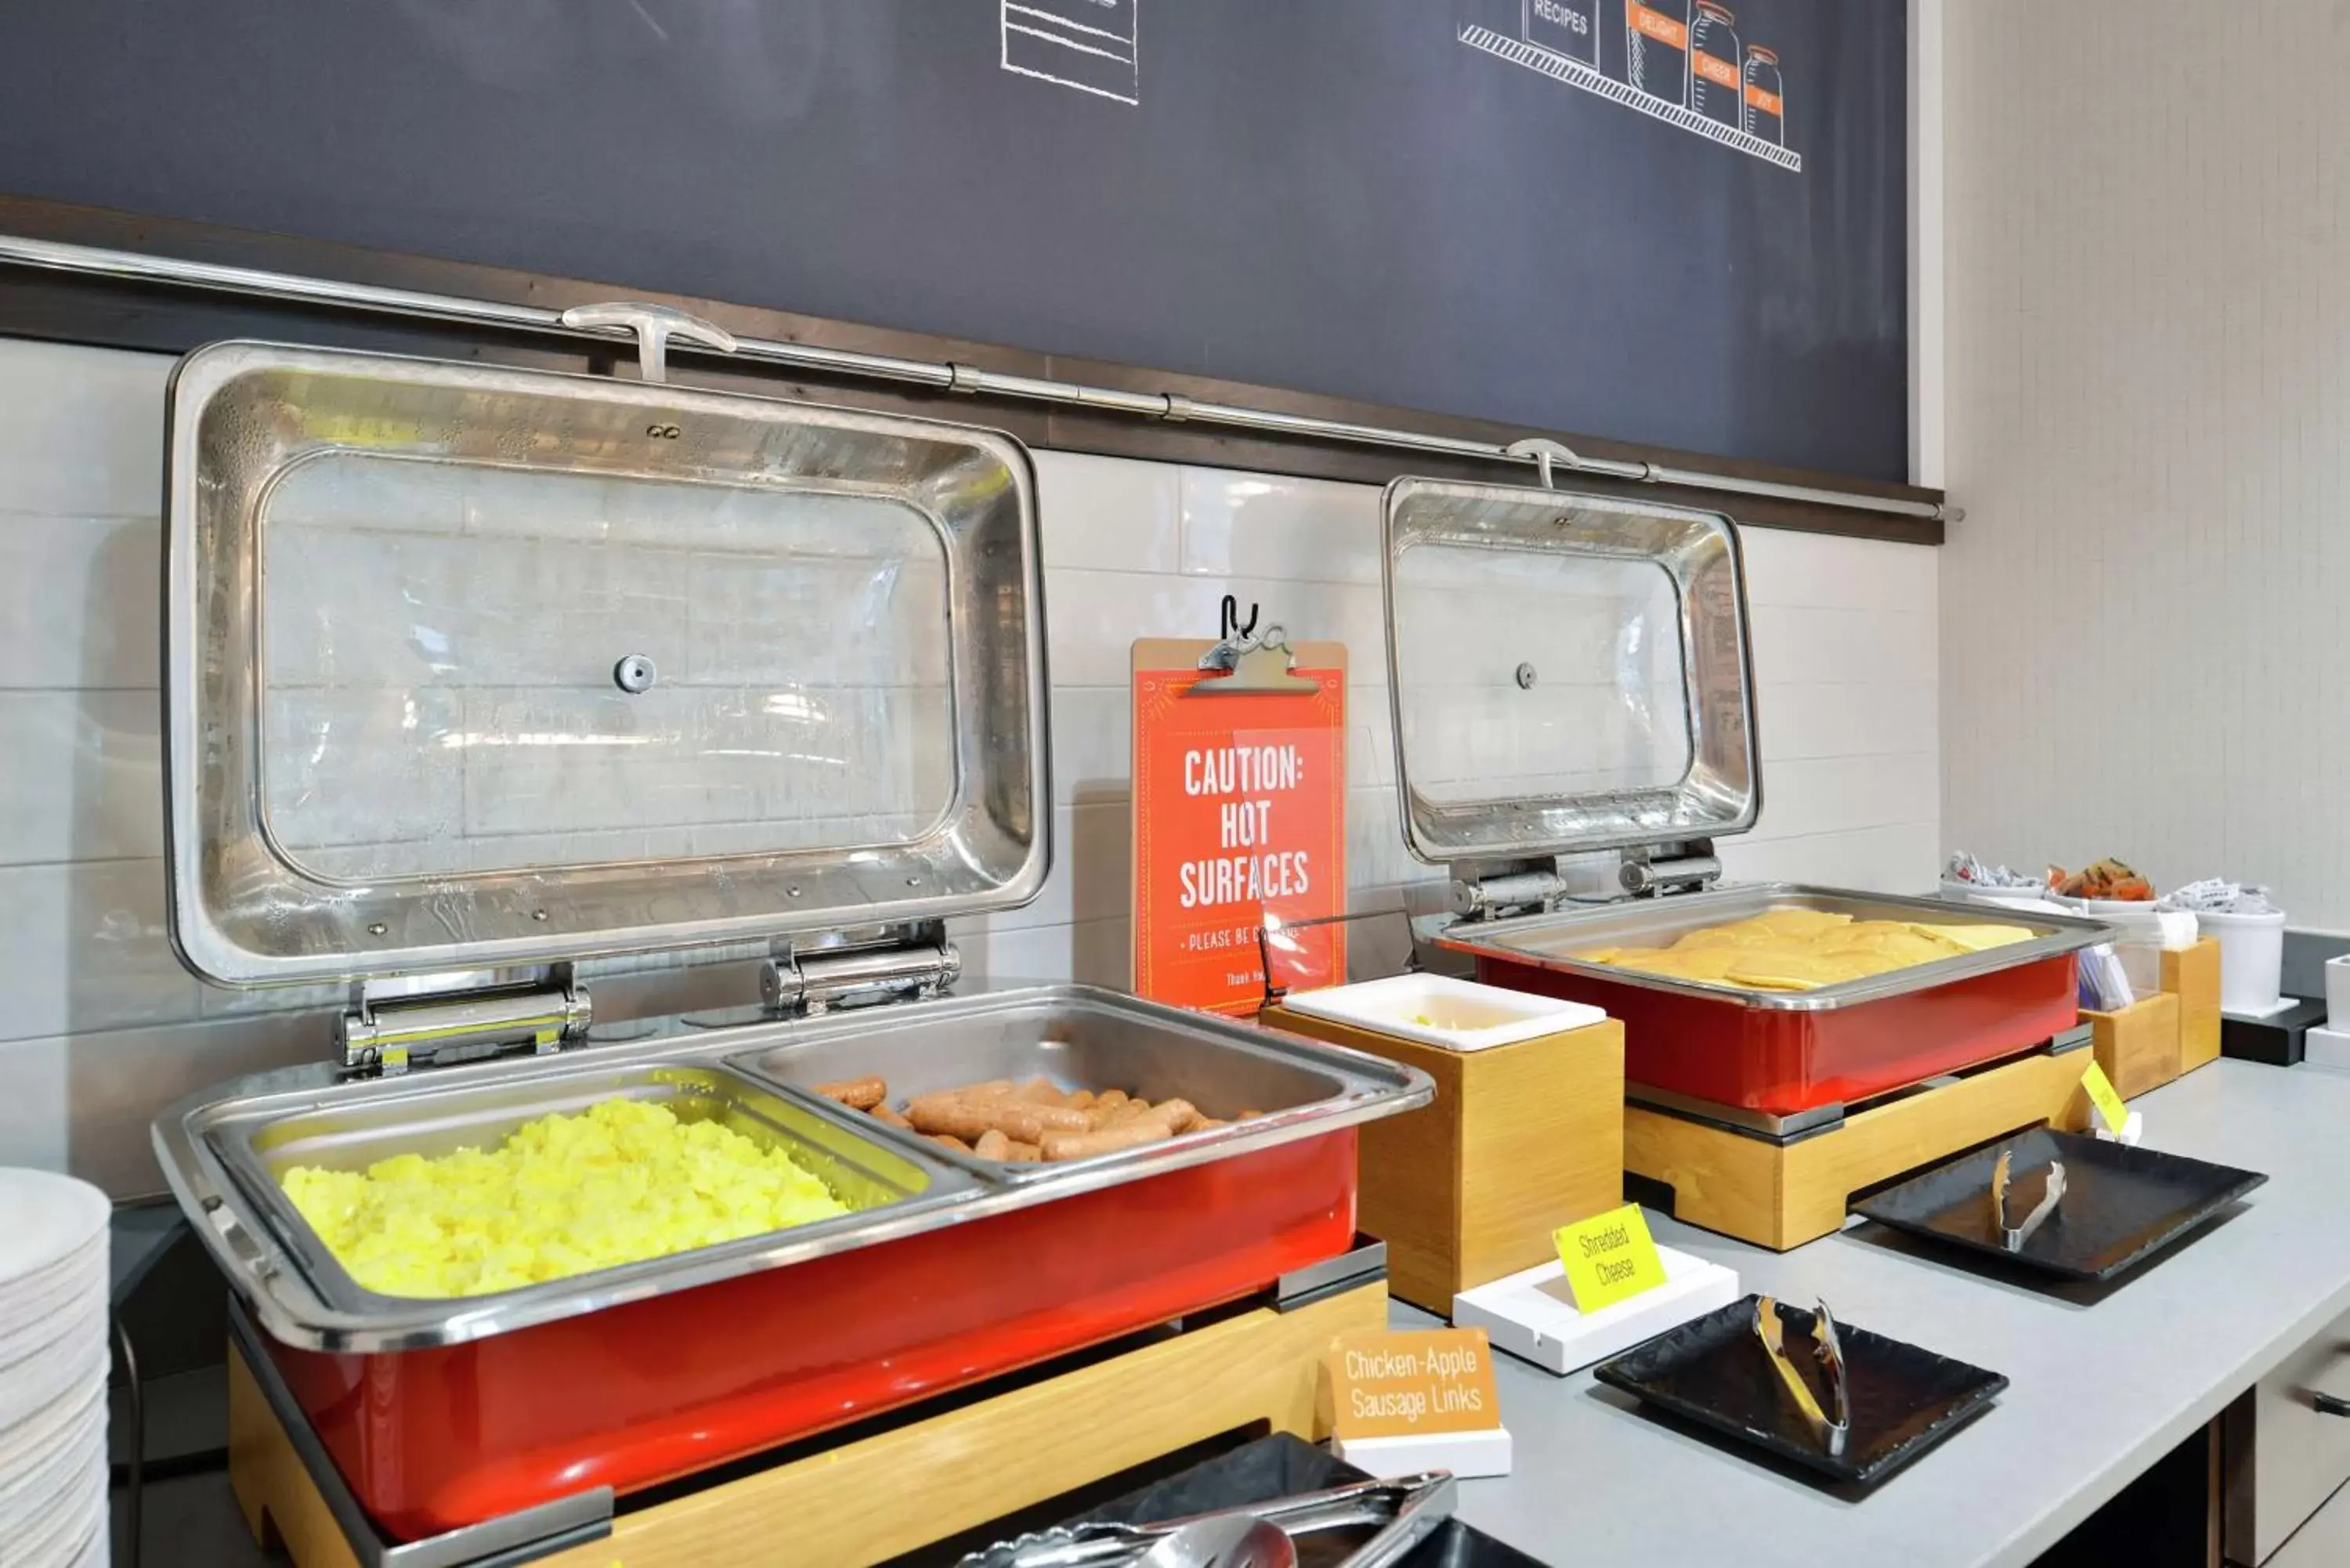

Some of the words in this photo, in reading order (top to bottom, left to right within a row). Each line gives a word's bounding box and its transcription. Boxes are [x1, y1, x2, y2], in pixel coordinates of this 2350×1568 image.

[1534, 0, 1588, 34] RECIPES
[1184, 745, 1303, 796] CAUTION:
[1220, 800, 1271, 848] HOT
[1180, 851, 1309, 908] SURFACES
[1189, 929, 1231, 951] PLEASE
[1235, 927, 1249, 945] BE
[1578, 1222, 1630, 1259] Shredded
[1595, 1258, 1636, 1286] Cheese
[1346, 1345, 1477, 1381] Chicken-Apple
[1351, 1387, 1426, 1423] Sausage
[1431, 1382, 1483, 1414] Links
